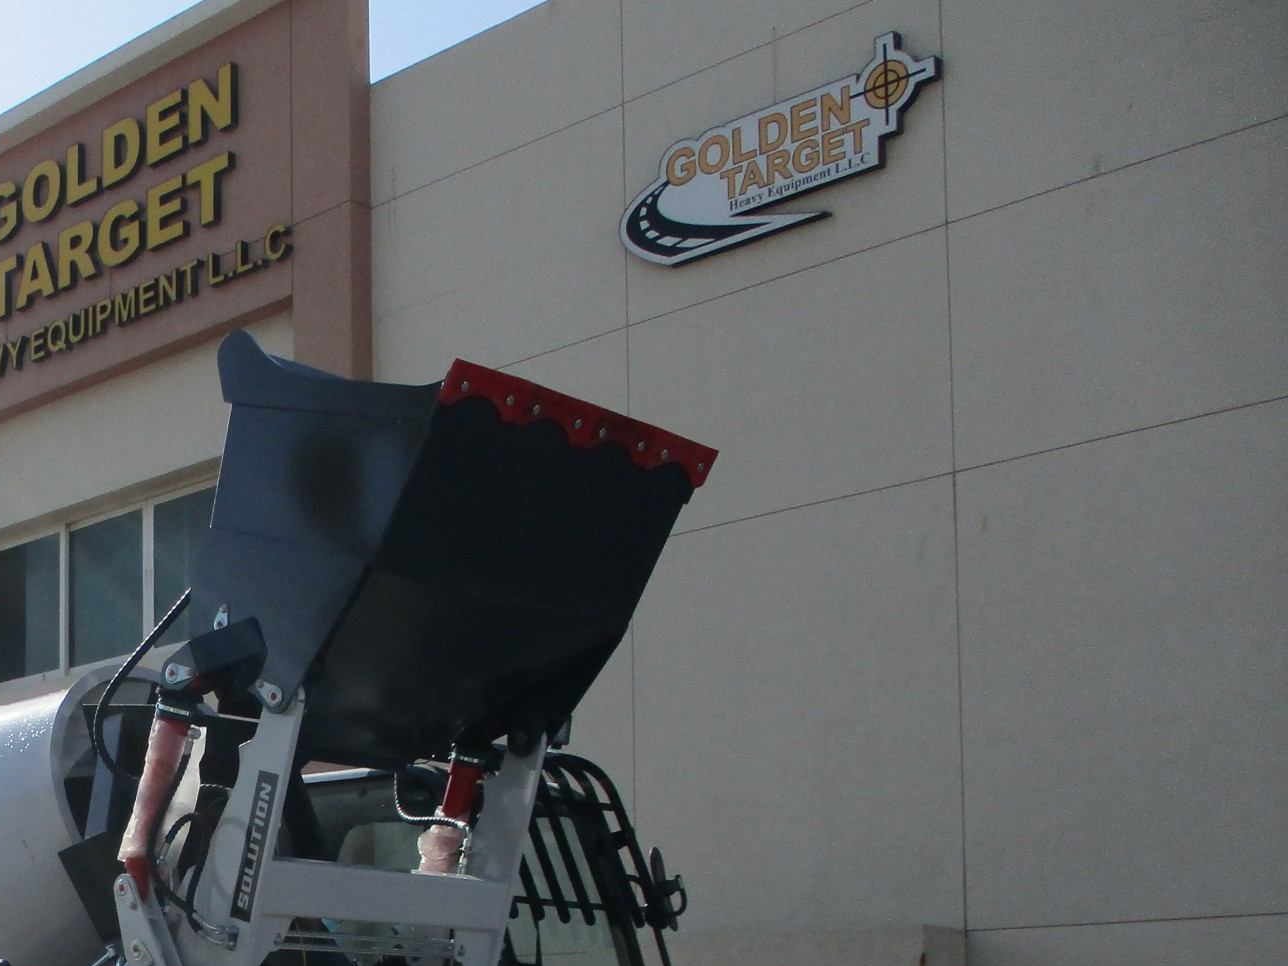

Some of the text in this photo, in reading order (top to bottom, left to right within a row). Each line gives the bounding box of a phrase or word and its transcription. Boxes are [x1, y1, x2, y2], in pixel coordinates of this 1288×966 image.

[666, 85, 852, 186] GOLDEN
[720, 118, 870, 200] TARGET
[729, 152, 870, 211] Heavy Equipment L.L.C
[30, 260, 202, 362] EQUIPMENT
[208, 225, 292, 287] L.L.C
[237, 781, 271, 911] SOLUTION
